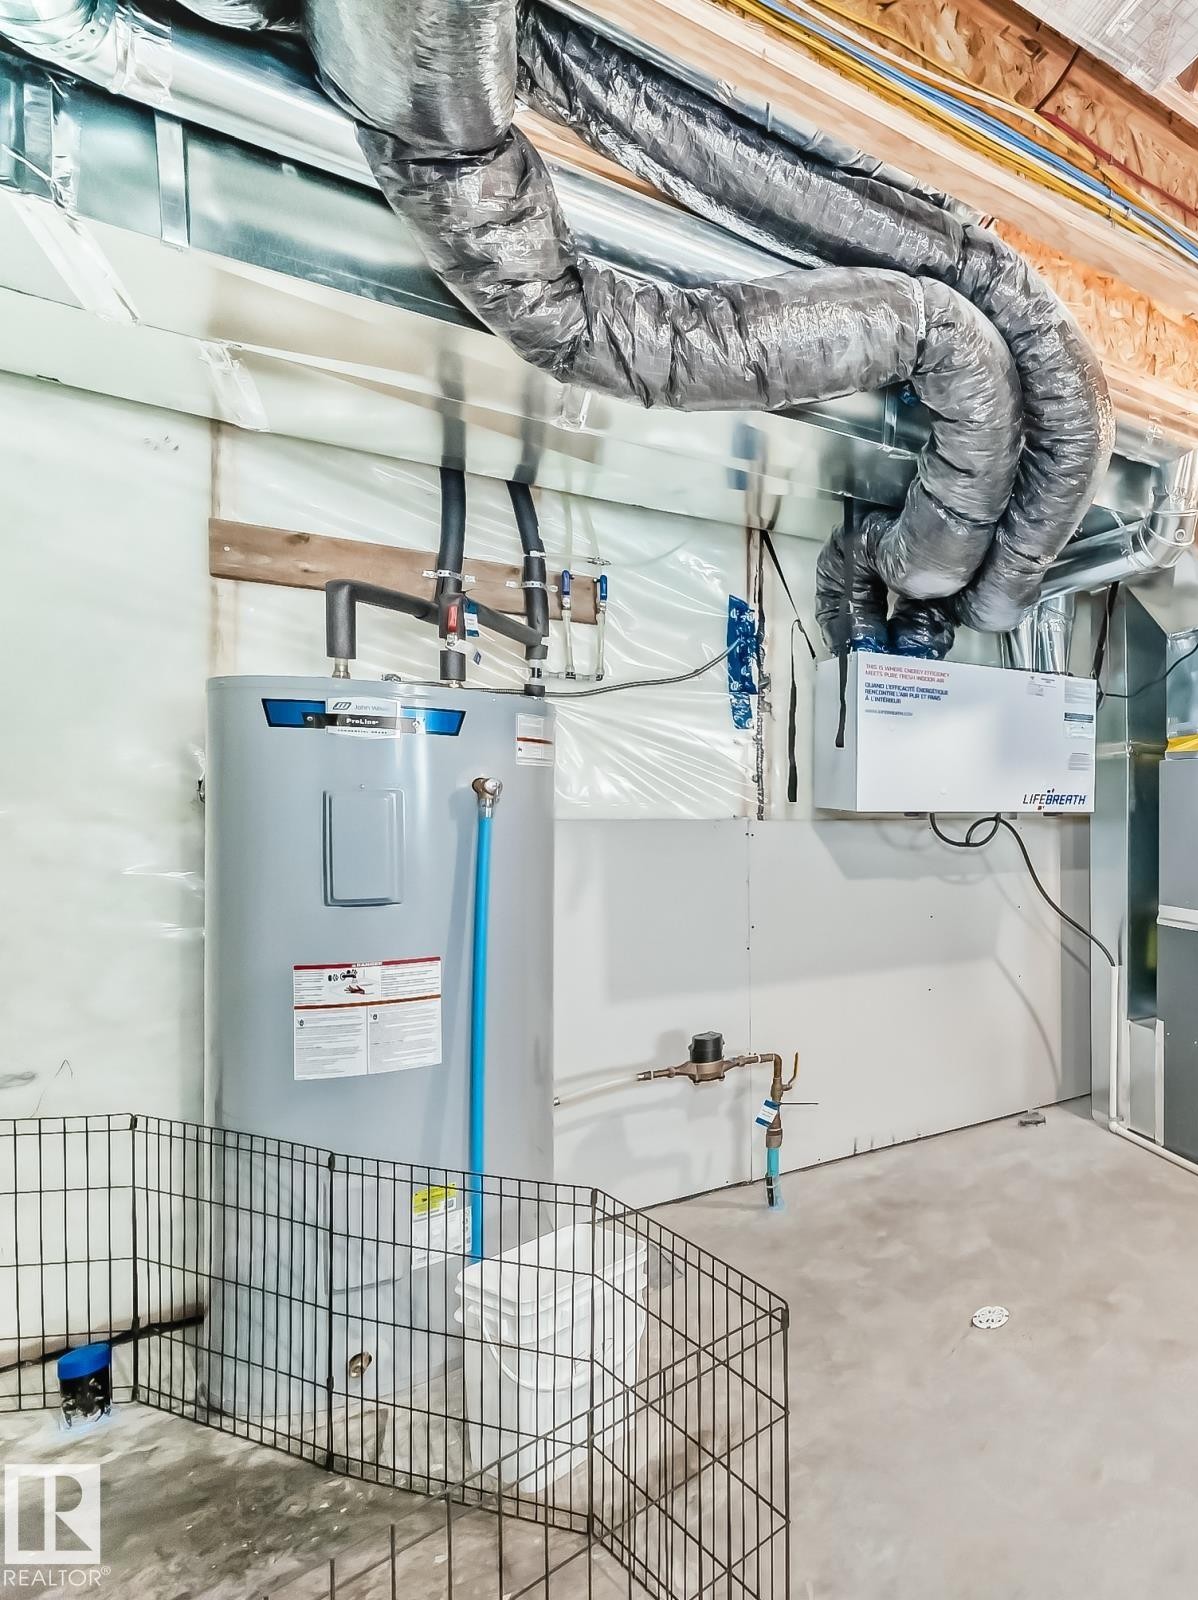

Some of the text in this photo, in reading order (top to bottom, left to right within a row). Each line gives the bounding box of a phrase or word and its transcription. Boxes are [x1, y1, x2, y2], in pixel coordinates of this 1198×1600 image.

[865, 689, 895, 697] RENCONTRE
[346, 717, 378, 725] ProLine
[1023, 793, 1087, 805] LIFEBREATH
